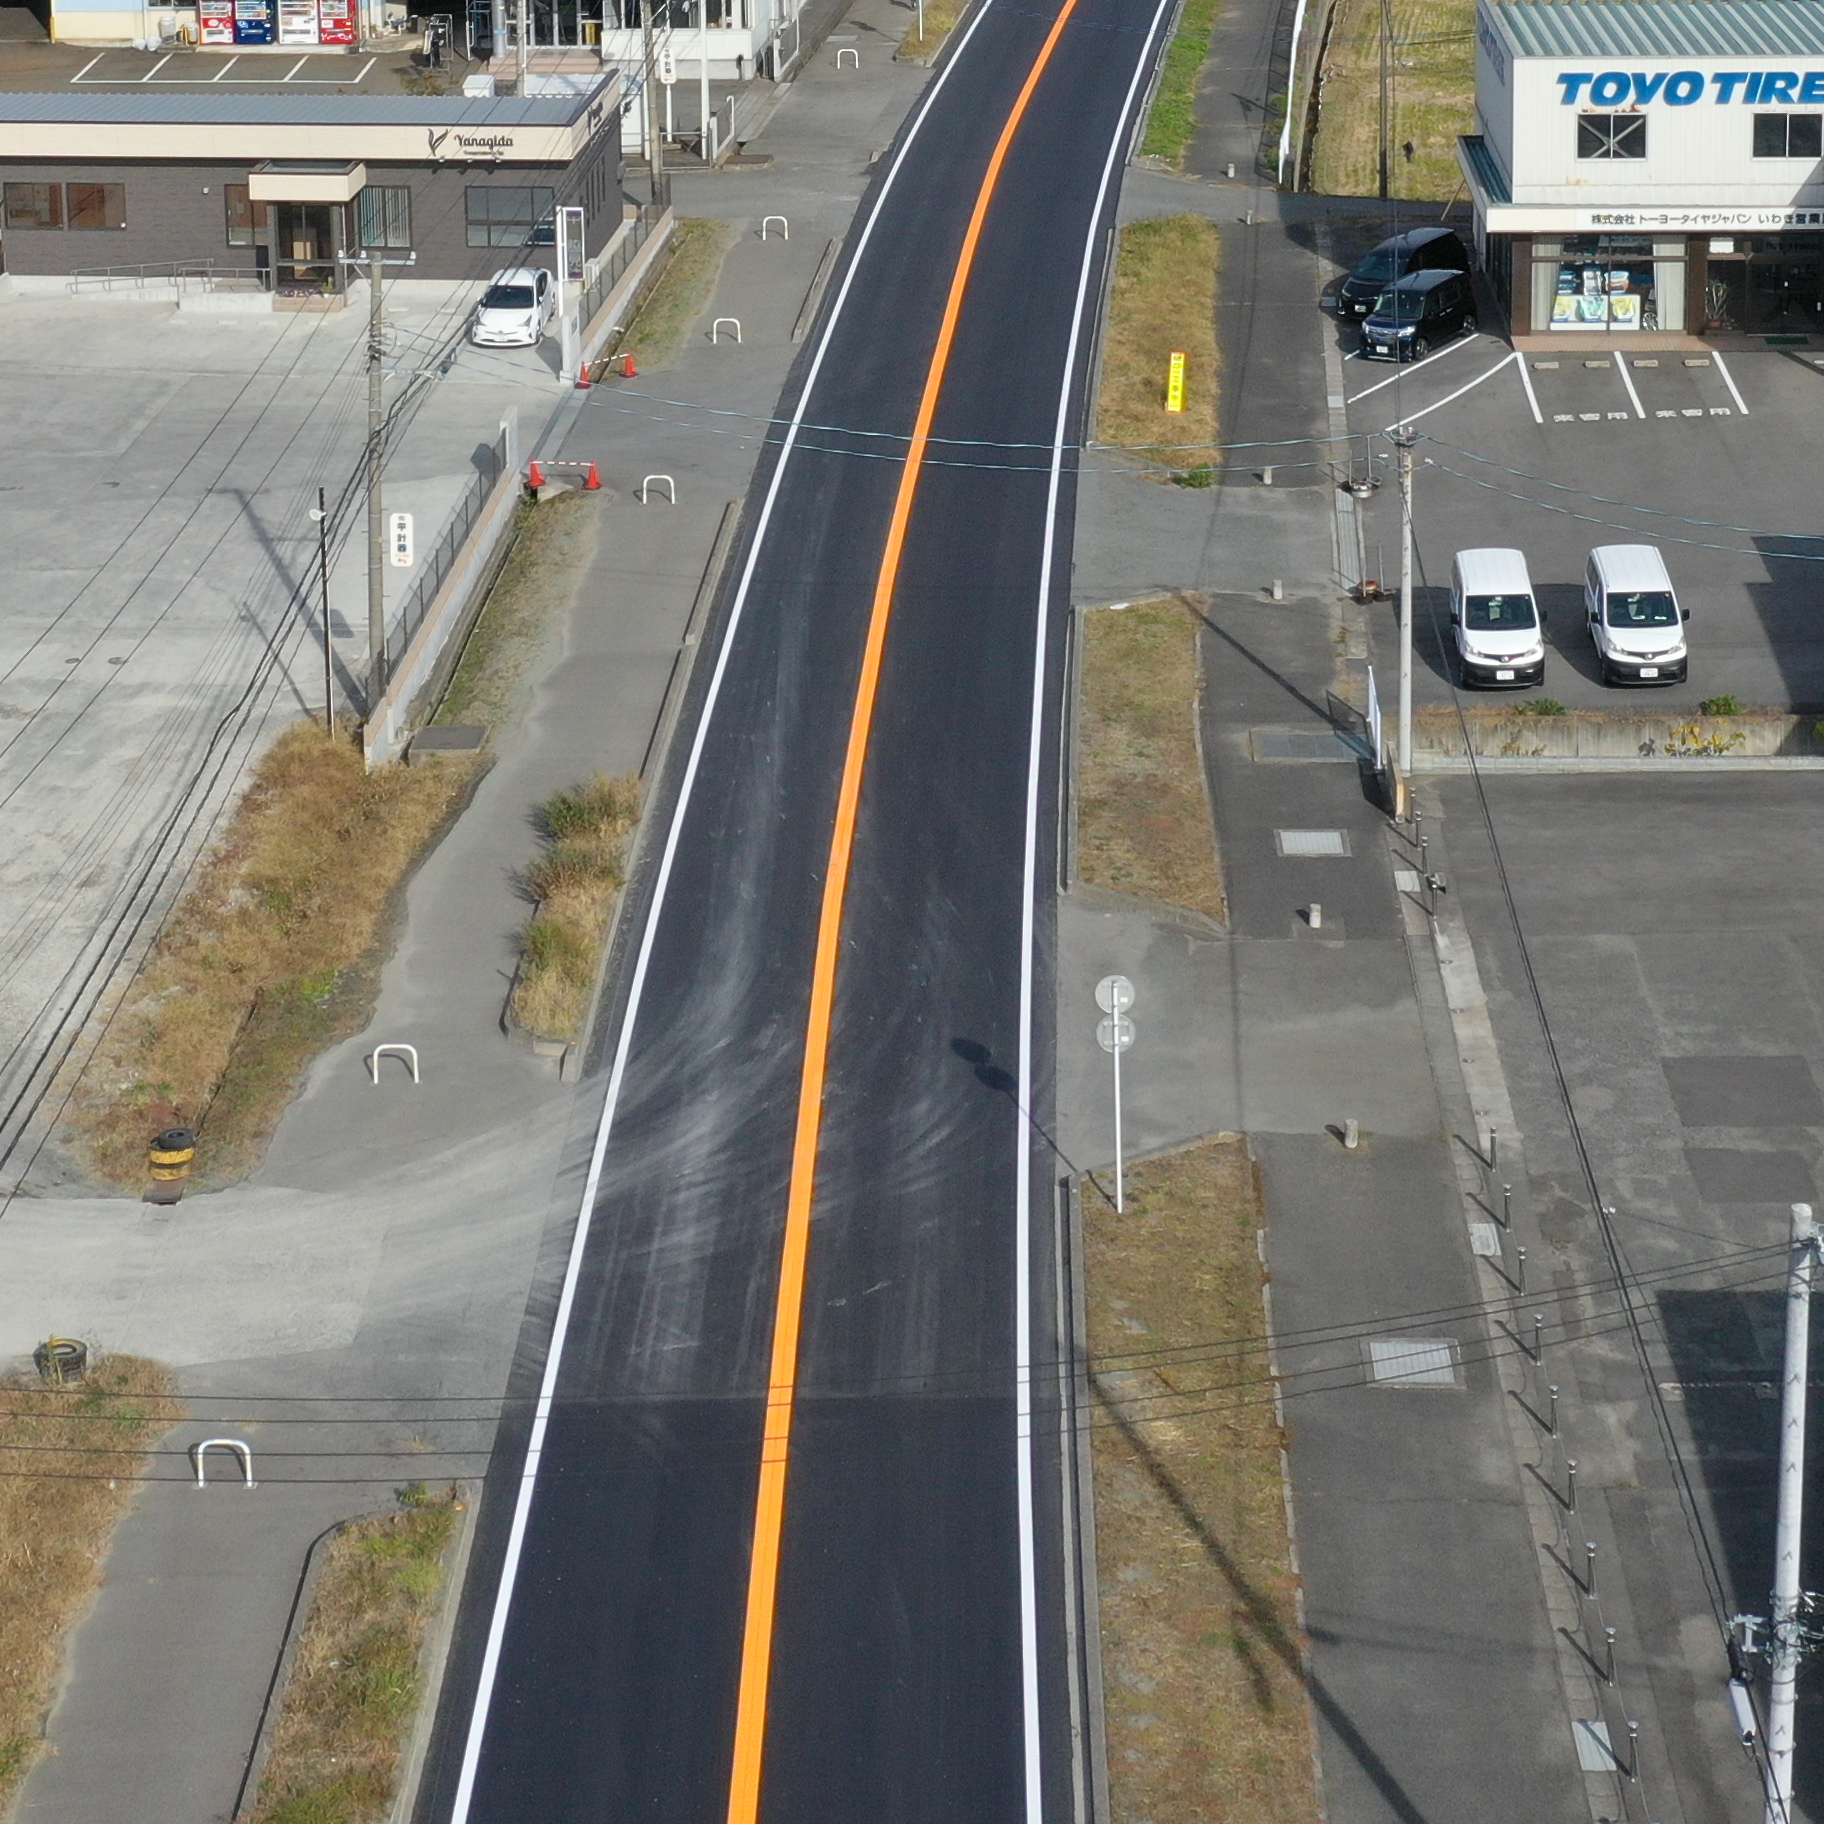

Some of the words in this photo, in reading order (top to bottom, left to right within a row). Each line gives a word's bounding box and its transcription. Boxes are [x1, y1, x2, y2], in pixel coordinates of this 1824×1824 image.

[1556, 71, 1704, 106] TOYO
[454, 133, 514, 149] Yanagida
[1592, 213, 1635, 225] 株式会社
[1638, 213, 1752, 225] トーヨータイヤジャパン
